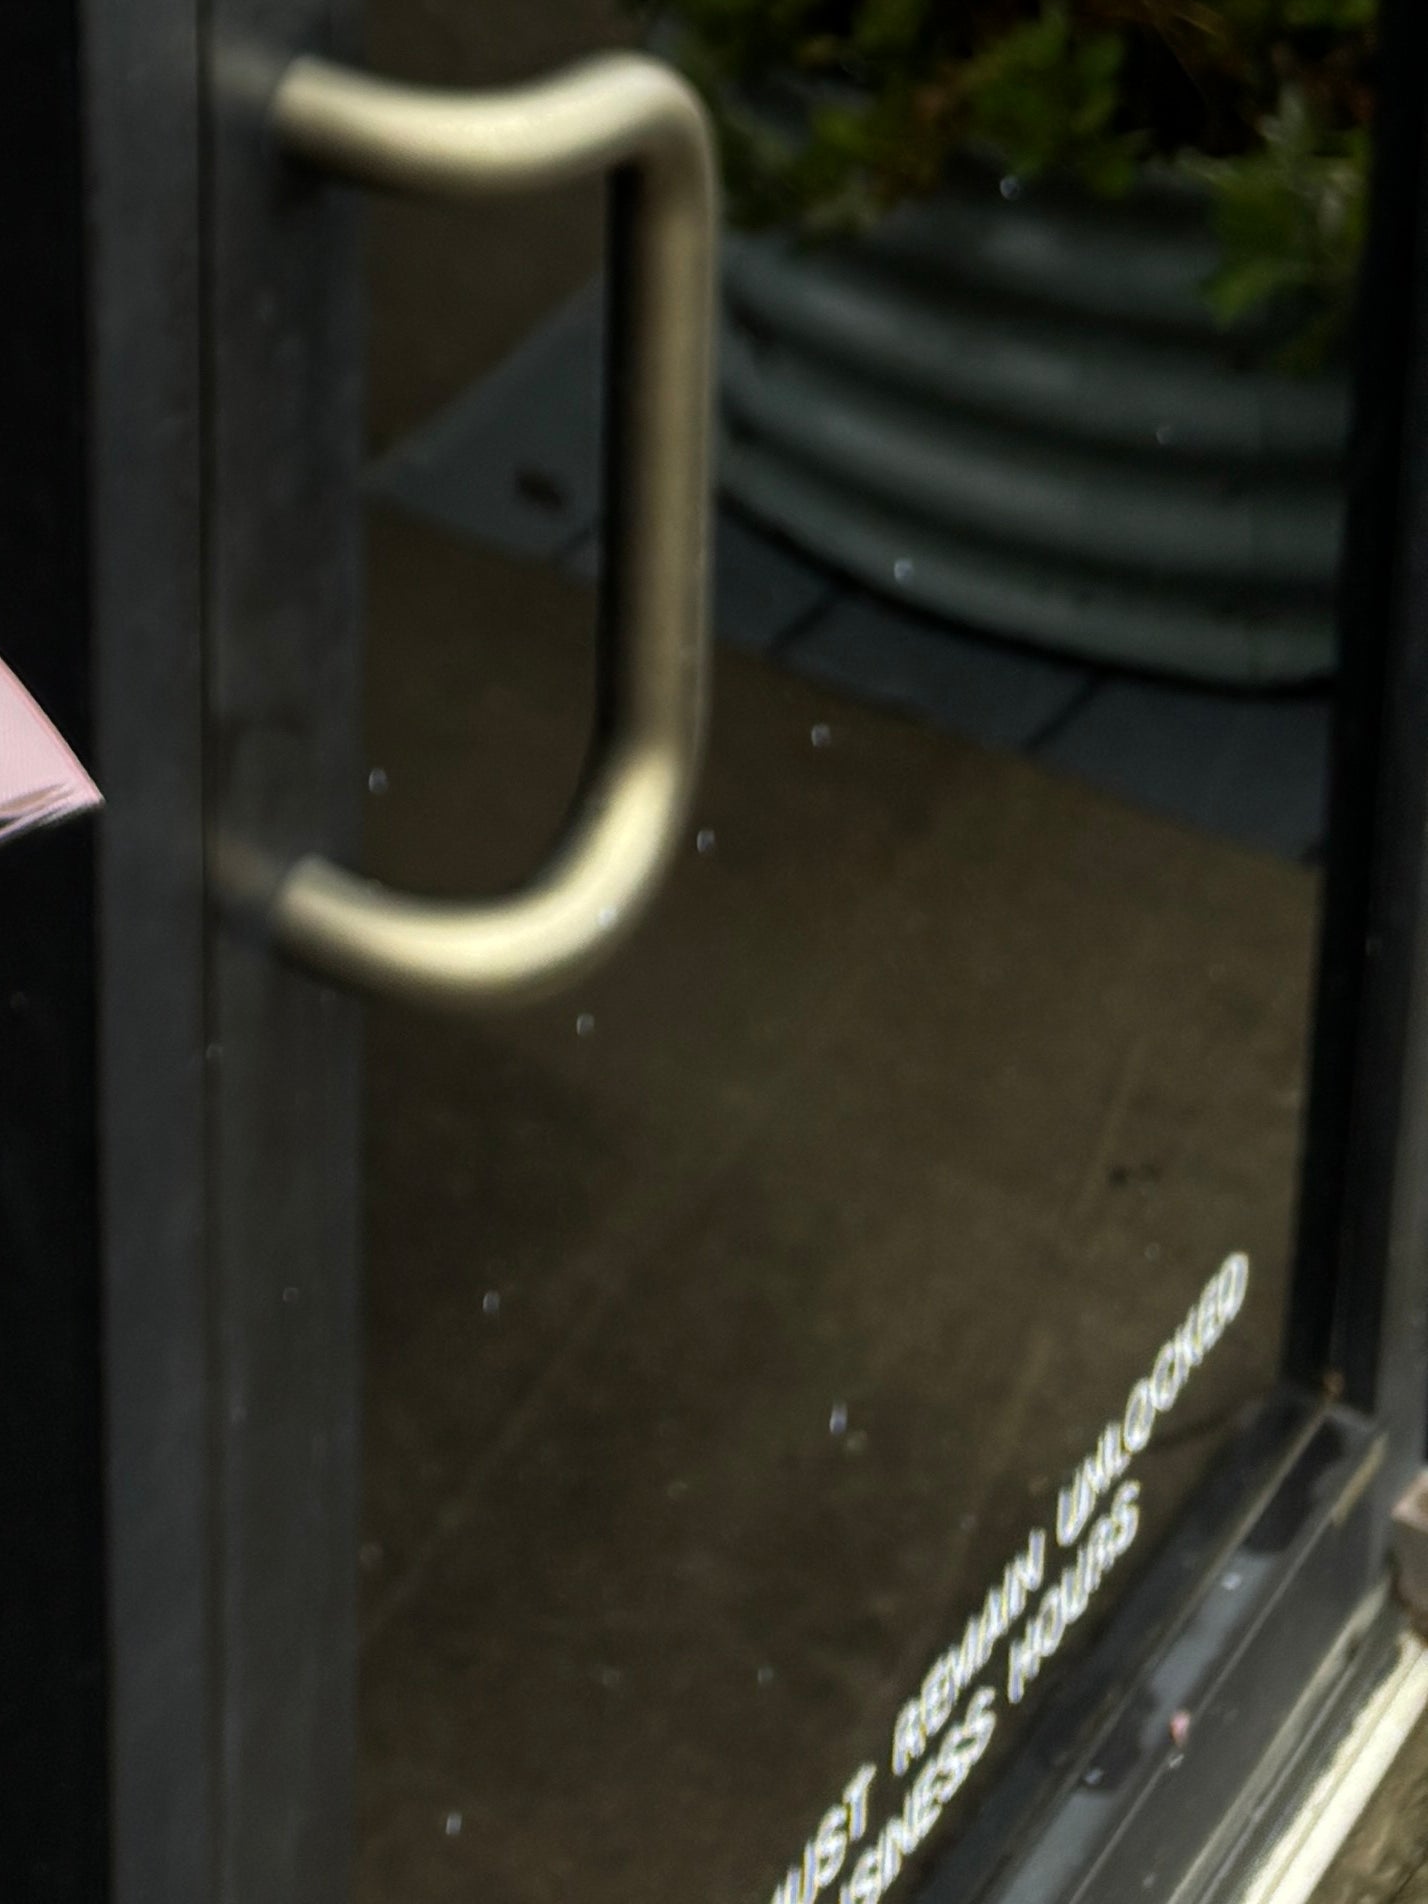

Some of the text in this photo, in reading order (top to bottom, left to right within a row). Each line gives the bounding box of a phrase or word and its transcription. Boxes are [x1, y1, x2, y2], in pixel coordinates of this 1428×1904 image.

[892, 1529, 1045, 1776] REMAIN
[1057, 1252, 1249, 1547] UNLOCKED
[1008, 1480, 1141, 1703] HOURS
